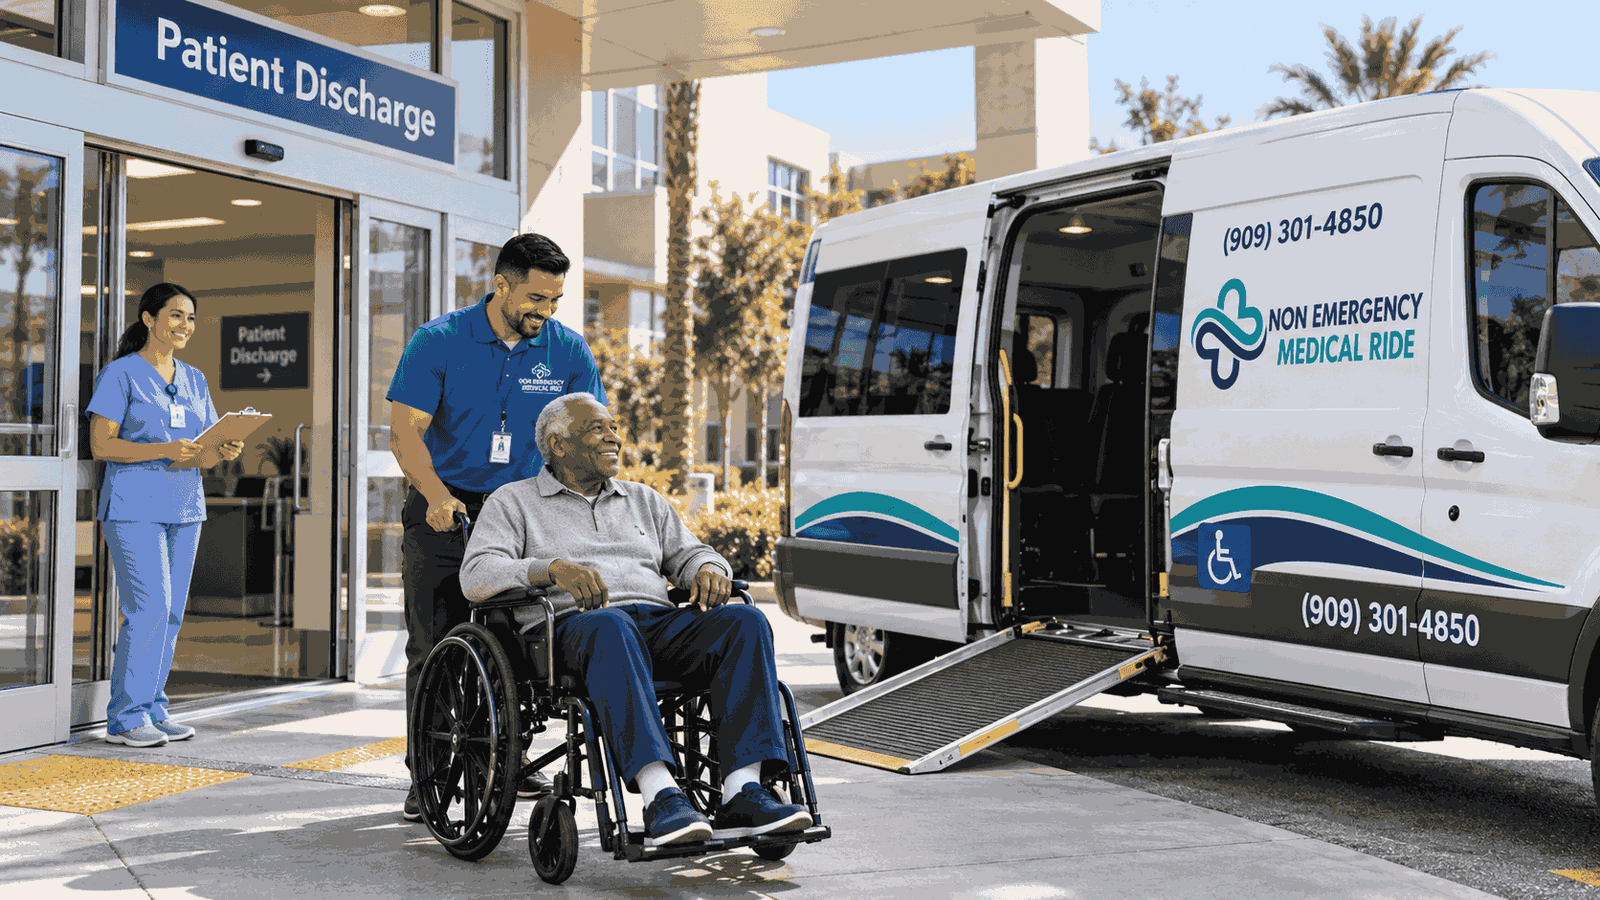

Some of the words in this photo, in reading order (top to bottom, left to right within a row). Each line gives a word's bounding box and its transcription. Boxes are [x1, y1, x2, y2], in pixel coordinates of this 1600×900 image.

[157, 17, 284, 95] Patient
[295, 60, 436, 142] Discharge
[1223, 222, 1272, 257] (909)
[1277, 202, 1383, 244] 301-4850
[1268, 305, 1308, 332] NON
[1312, 292, 1424, 328] EMERGENCY
[238, 324, 286, 342] Patient
[1276, 333, 1364, 366] MEDICAL
[1369, 329, 1416, 361] RIDE
[229, 346, 298, 367] Discharge
[1301, 592, 1361, 635] (909)
[1368, 601, 1481, 647] 301-4850
